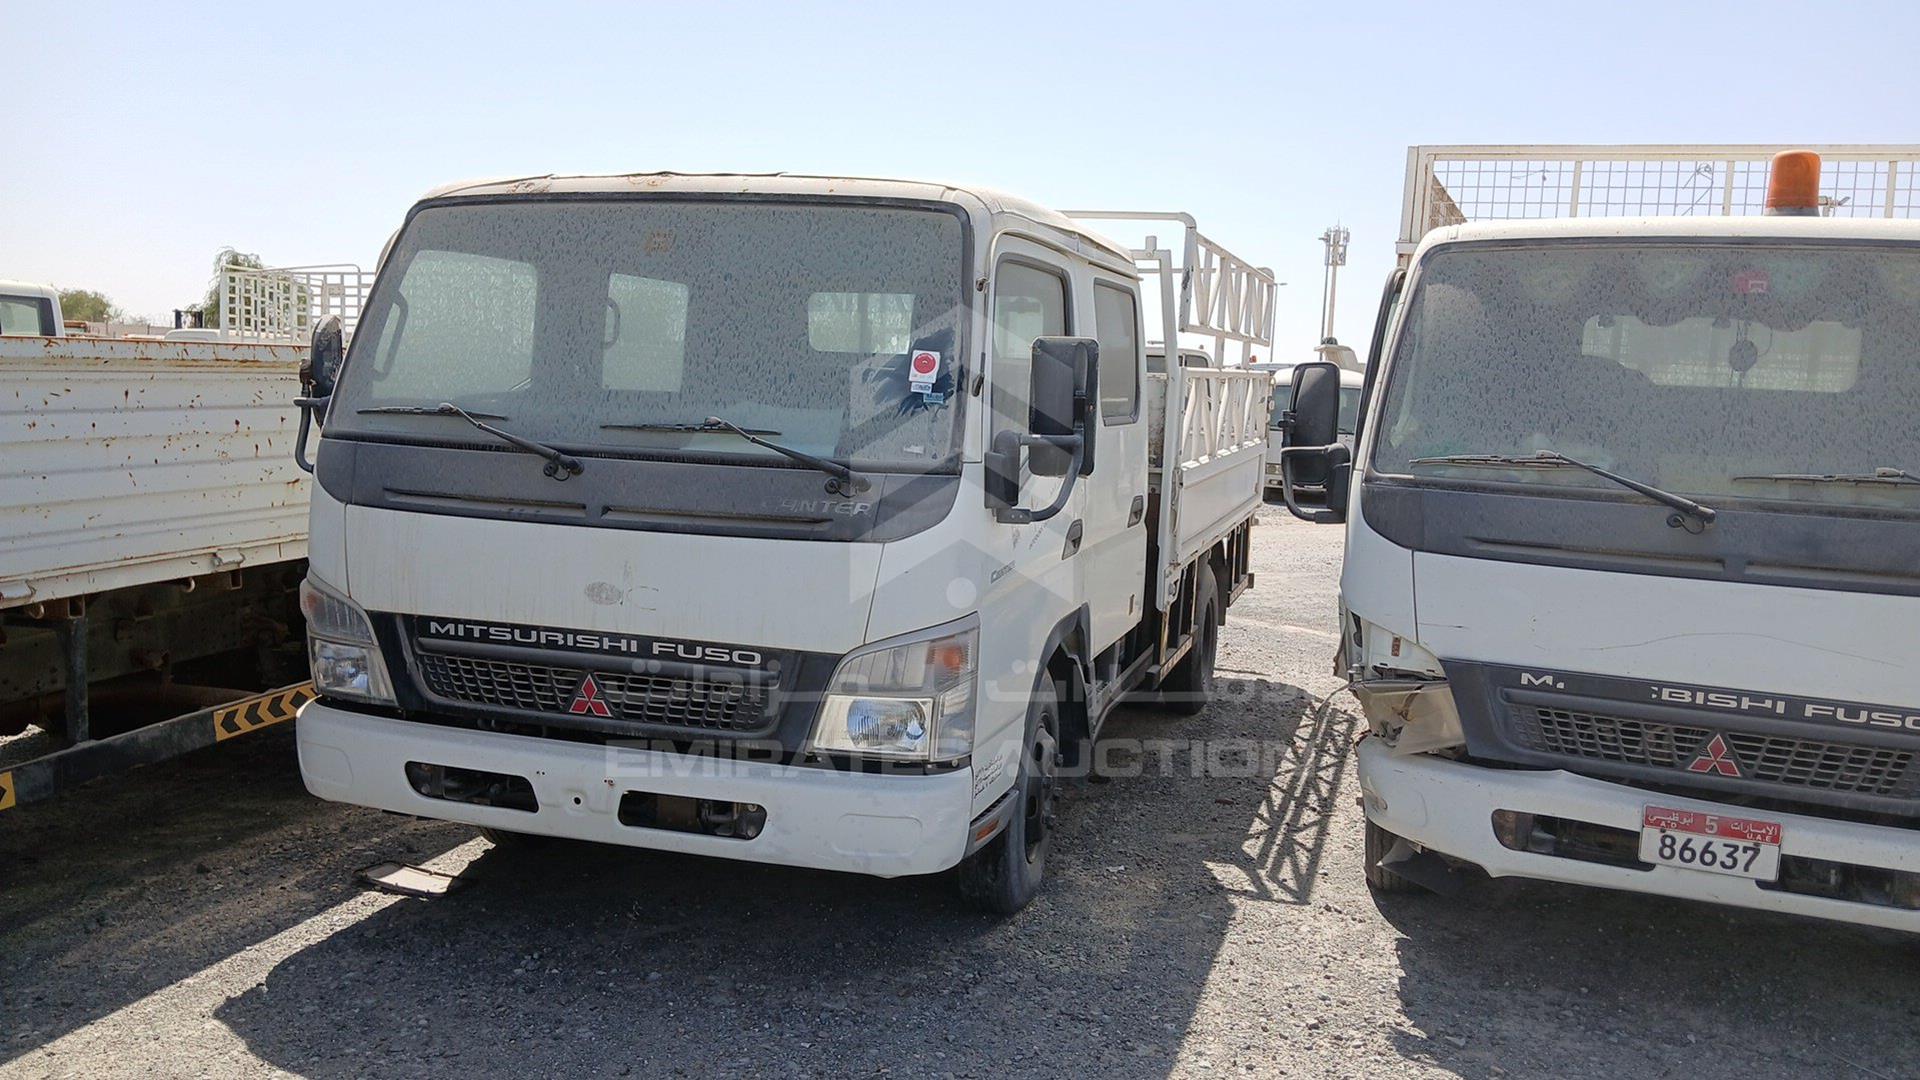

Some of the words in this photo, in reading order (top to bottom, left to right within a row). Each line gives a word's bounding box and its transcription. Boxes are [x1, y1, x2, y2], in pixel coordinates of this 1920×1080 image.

[652, 641, 762, 666] FUSO
[1704, 815, 1718, 833] 5
[1658, 834, 1761, 872] 86637
